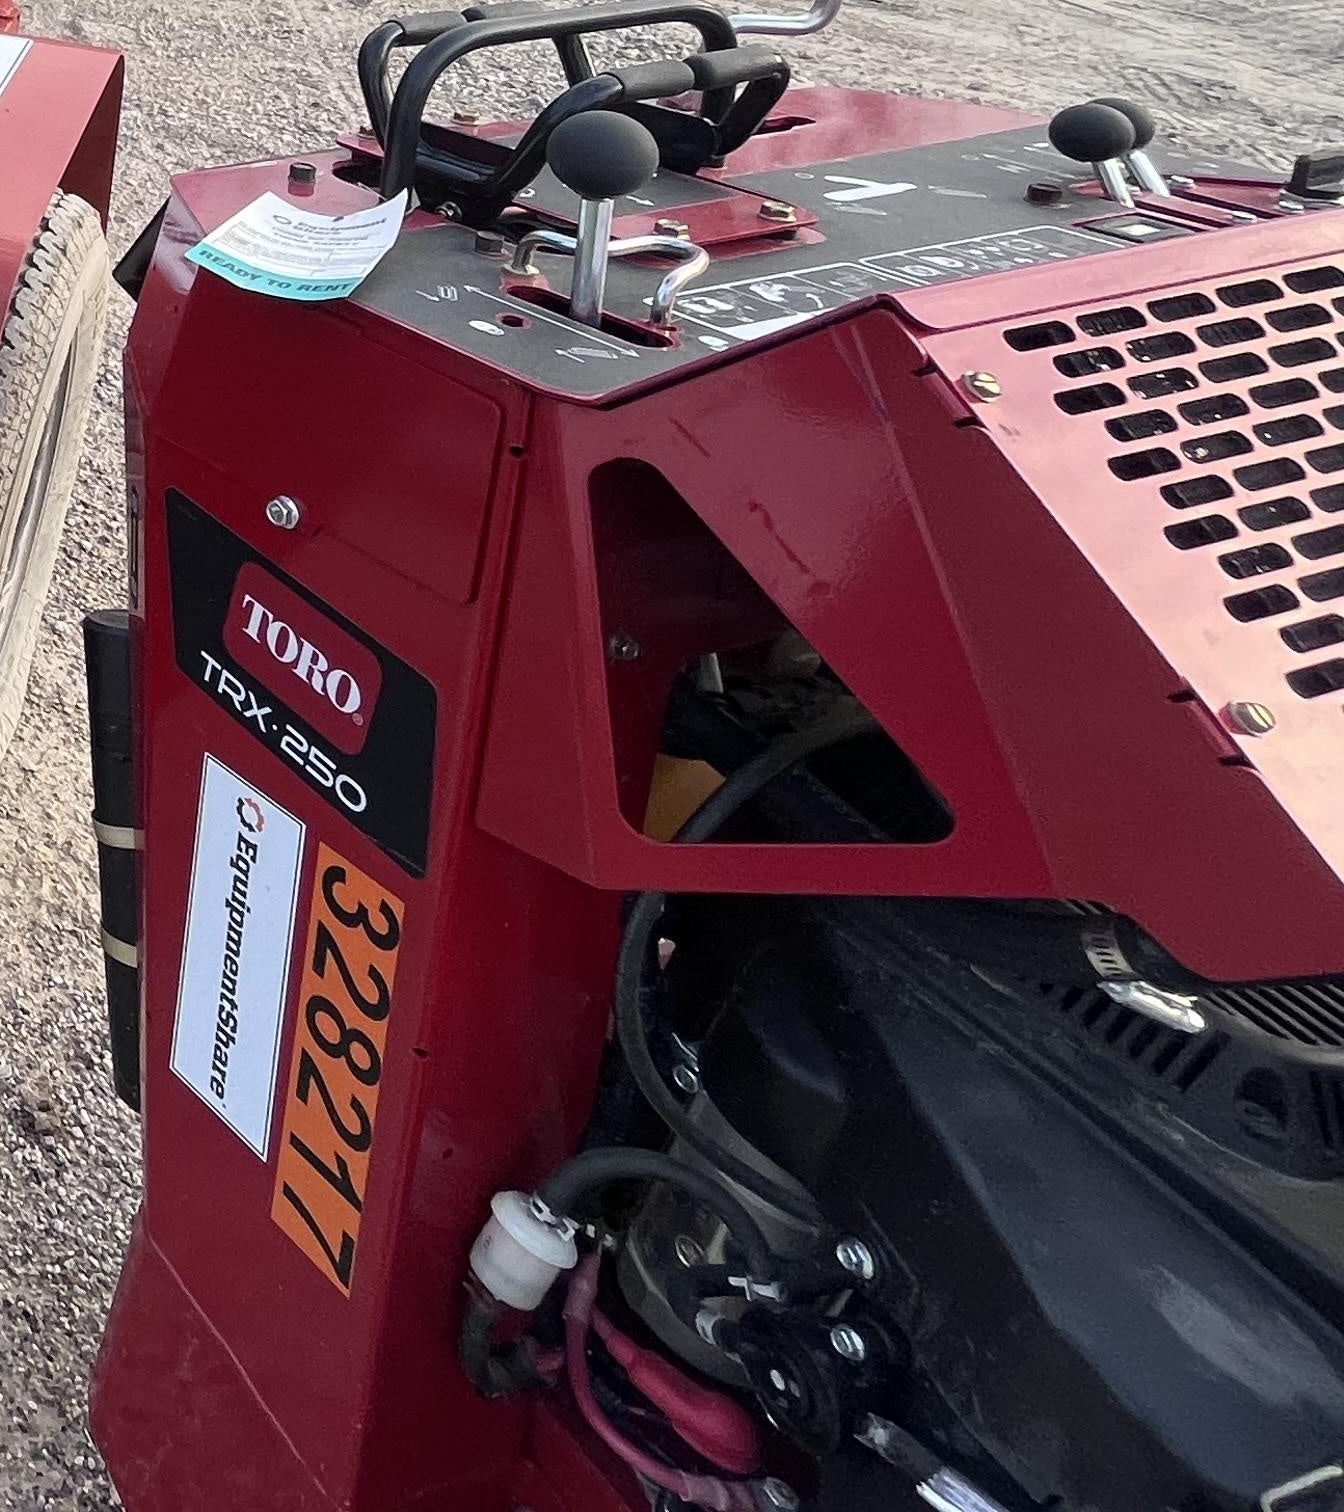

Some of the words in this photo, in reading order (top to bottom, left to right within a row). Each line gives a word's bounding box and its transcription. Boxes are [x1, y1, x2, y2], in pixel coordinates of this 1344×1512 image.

[198, 249, 262, 282] READY
[266, 278, 293, 290] TO
[296, 282, 352, 293] RENT
[241, 593, 363, 716] TORO
[208, 832, 262, 1104] EquipmentShare
[280, 864, 402, 1286] 328217
